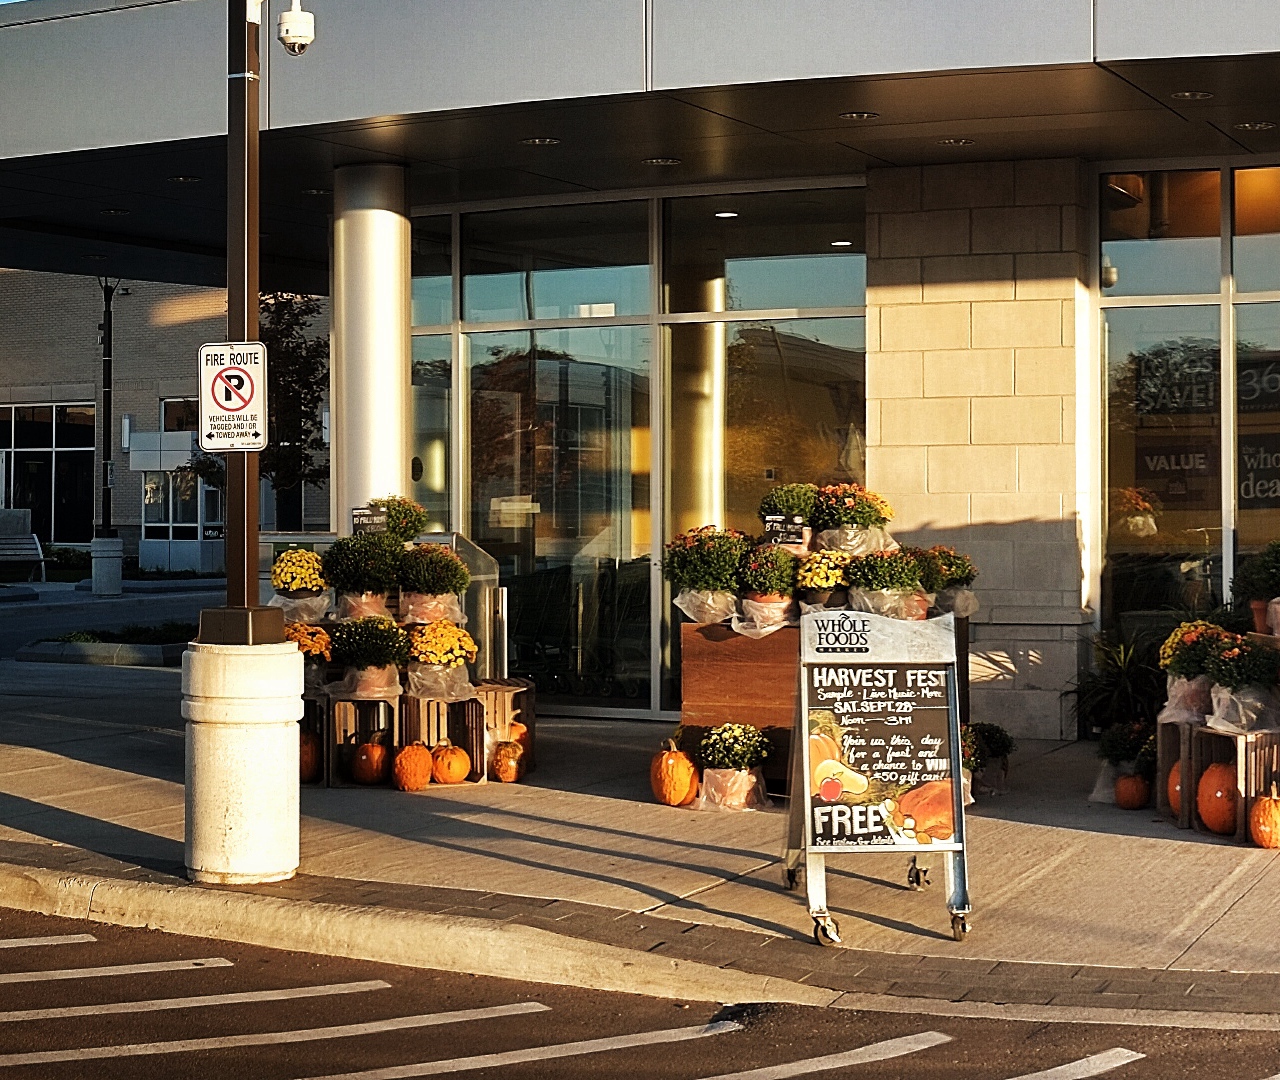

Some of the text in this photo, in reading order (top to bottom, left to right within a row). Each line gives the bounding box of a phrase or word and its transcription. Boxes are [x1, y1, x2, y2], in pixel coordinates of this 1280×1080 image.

[205, 352, 259, 366] FIRE ROUTE
[208, 414, 235, 422] VEHICLES
[215, 431, 236, 439] TOWED
[1145, 453, 1207, 471] VALUE
[815, 613, 871, 632] WHOLE
[817, 633, 868, 646] FOODS
[813, 667, 949, 687] HARVEST FEST
[817, 687, 854, 700] Sample
[862, 688, 887, 700] Live
[887, 688, 915, 699] Music
[920, 734, 945, 754] day
[848, 747, 867, 764] for
[872, 751, 881, 759] a
[860, 762, 870, 771] a
[872, 760, 908, 770] chance
[911, 759, 923, 770] to
[899, 771, 919, 785] gift
[814, 805, 883, 836] FREE
